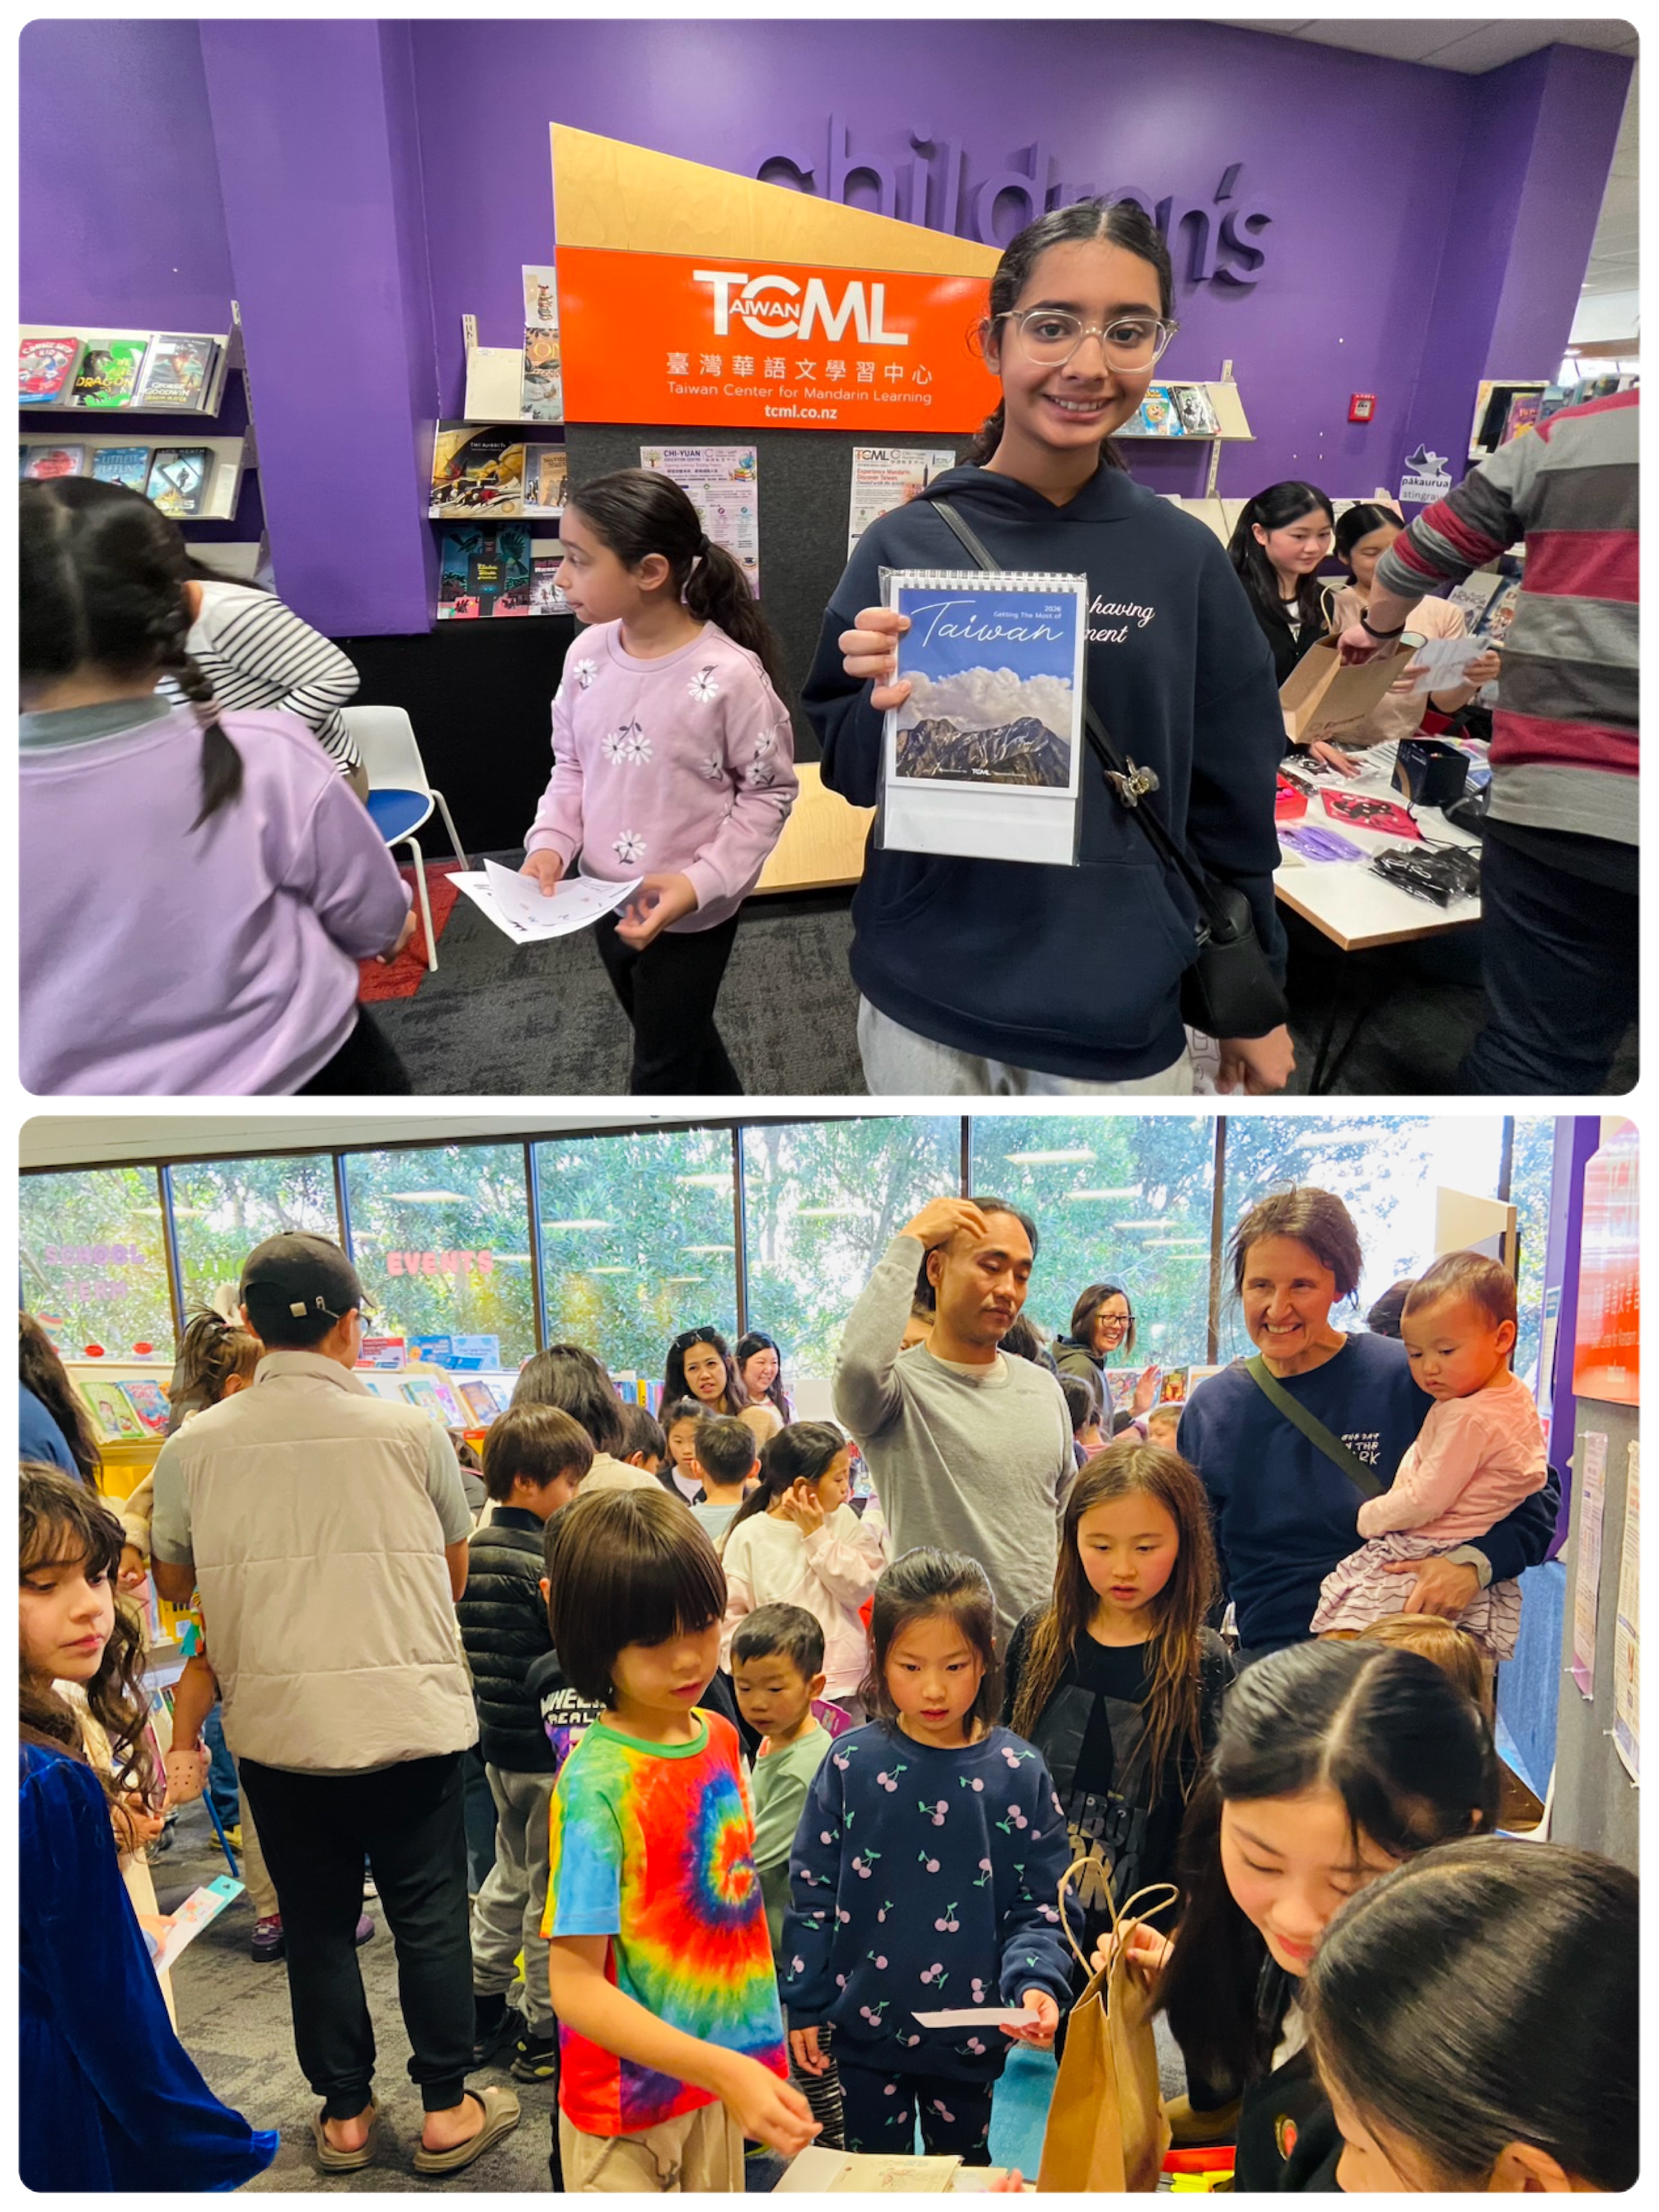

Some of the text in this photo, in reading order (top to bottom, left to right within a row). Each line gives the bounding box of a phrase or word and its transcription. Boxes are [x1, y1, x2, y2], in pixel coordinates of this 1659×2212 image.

[693, 269, 908, 345] TCML
[666, 352, 932, 385] 臺灣華語文學習中心
[76, 376, 132, 387] DRAGON
[668, 381, 932, 405] Taiwan Center for Mandarin Learning
[765, 405, 838, 419] tcml.co.nz
[855, 449, 889, 461] TCML
[1089, 594, 1156, 628] having
[911, 599, 1064, 647] Taiwan
[44, 1243, 145, 1266] SCHOOL
[386, 1249, 494, 1276] EVENTS
[63, 1280, 127, 1303] TERM
[547, 1710, 601, 1725] REAL
